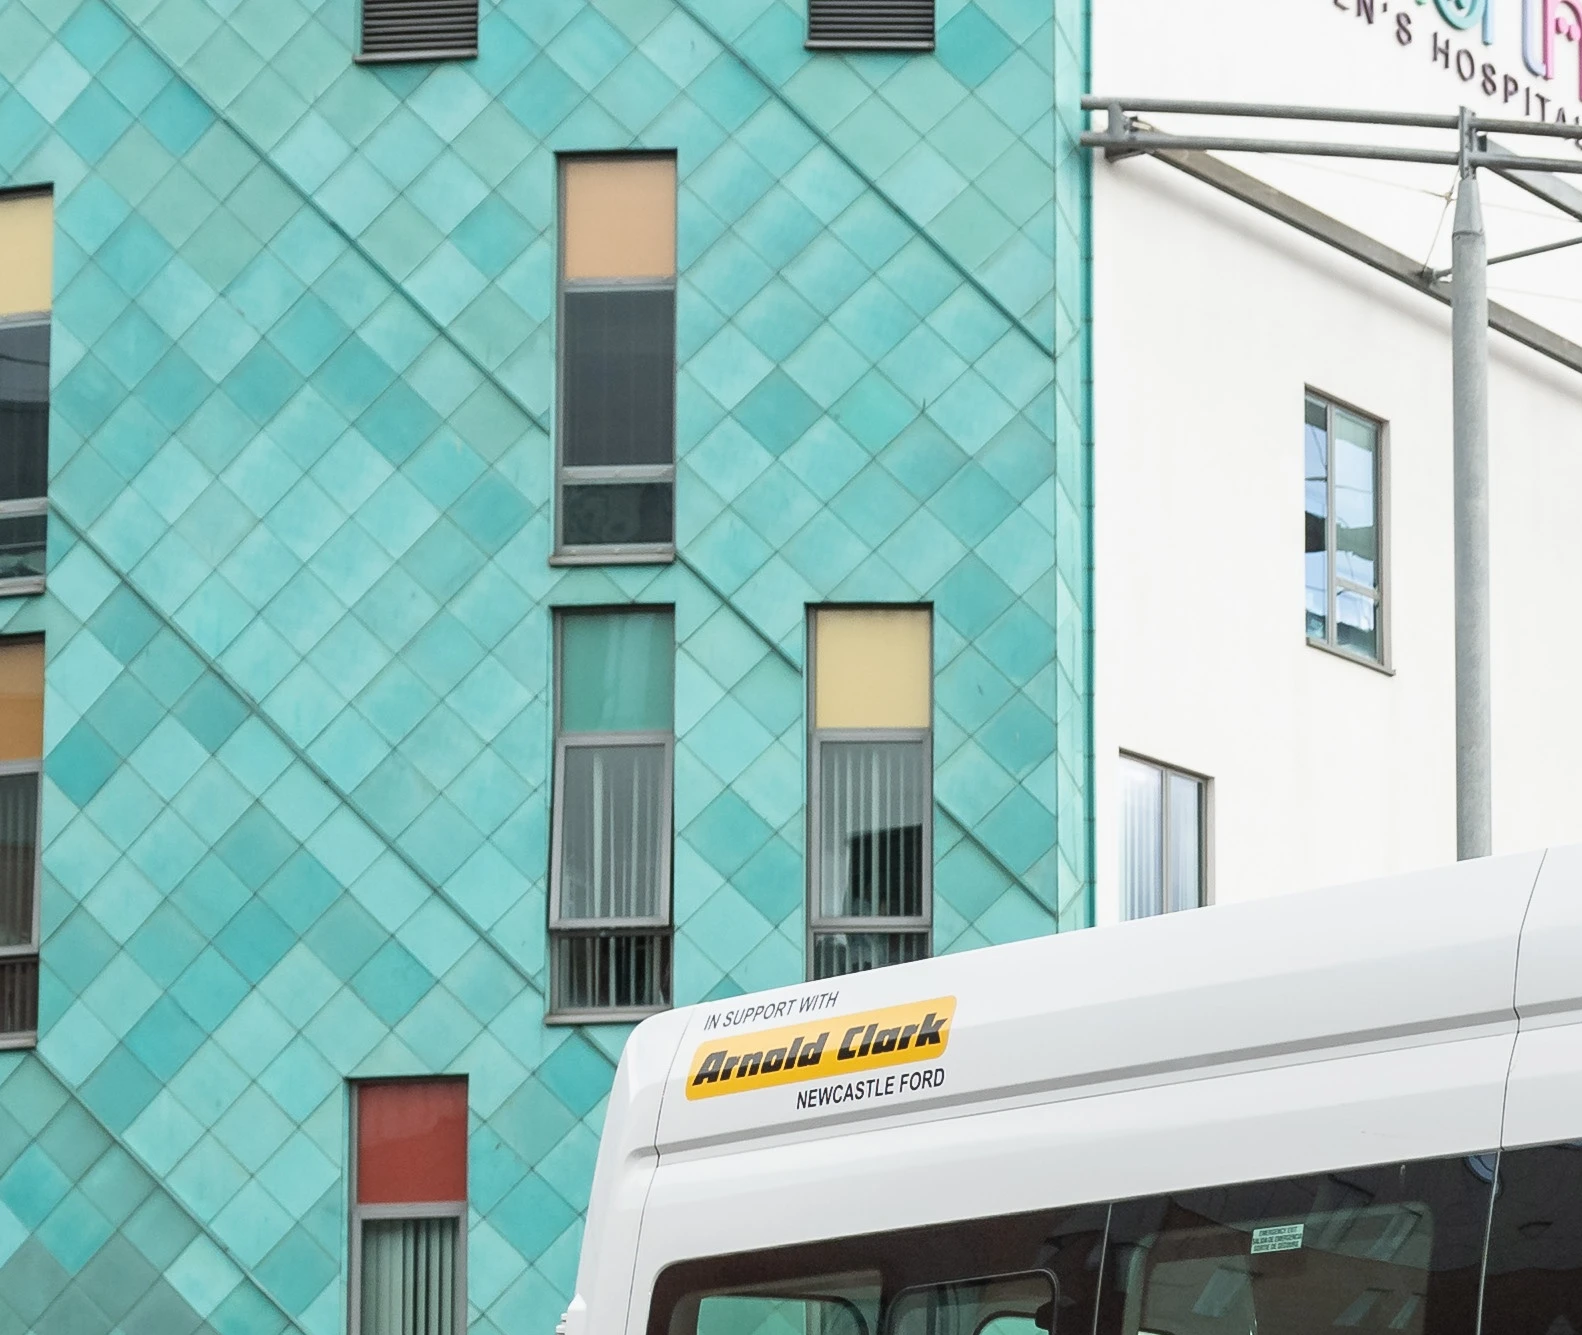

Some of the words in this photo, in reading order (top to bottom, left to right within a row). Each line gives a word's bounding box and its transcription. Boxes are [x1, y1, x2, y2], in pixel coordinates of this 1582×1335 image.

[704, 1013, 720, 1032] IN
[723, 998, 796, 1028] SUPPORT
[798, 991, 840, 1012] WITH
[691, 1031, 831, 1087] Arnold
[836, 1012, 949, 1060] Clark
[796, 1076, 895, 1111] NEWCASTLE
[899, 1067, 946, 1097] FORD
